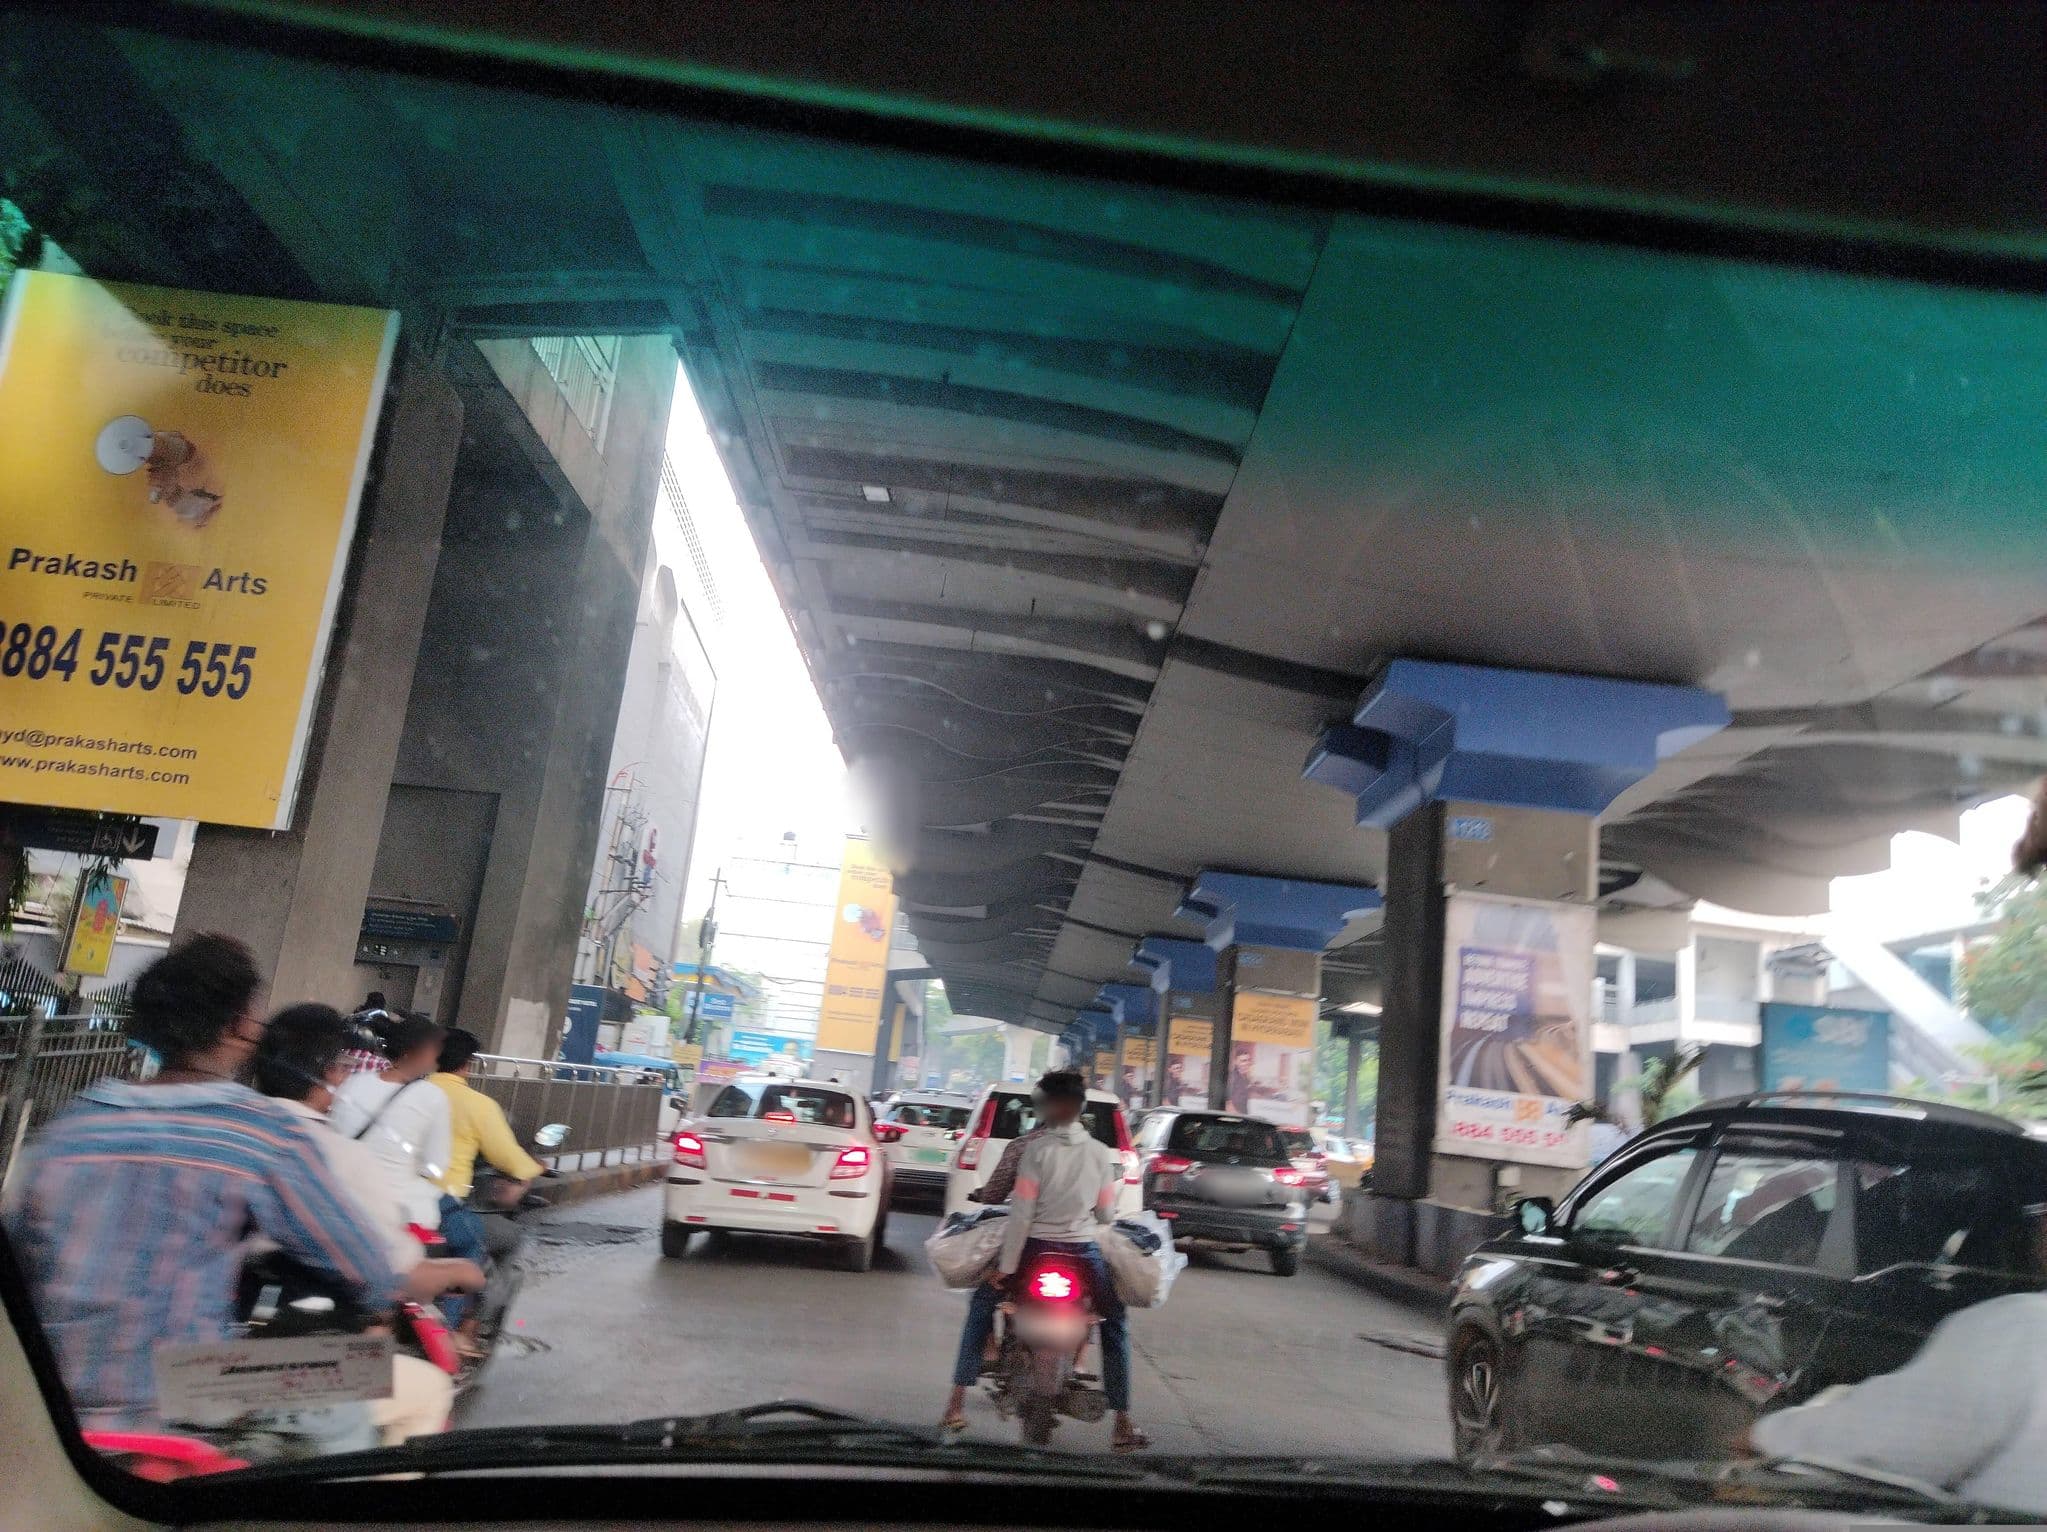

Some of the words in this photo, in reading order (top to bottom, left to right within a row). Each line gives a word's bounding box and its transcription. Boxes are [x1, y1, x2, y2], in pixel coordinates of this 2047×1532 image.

[117, 348, 288, 379] competitor
[195, 373, 252, 397] does
[8, 547, 138, 583] Prakash
[202, 566, 269, 596] Arts
[82, 590, 133, 604] PRIVATE
[152, 599, 201, 610] LIMITED
[91, 631, 170, 692] 555
[177, 640, 257, 701] 555
[0, 728, 197, 760] yd@prakasharts.com
[0, 753, 190, 785] ww.prakasharts.com
